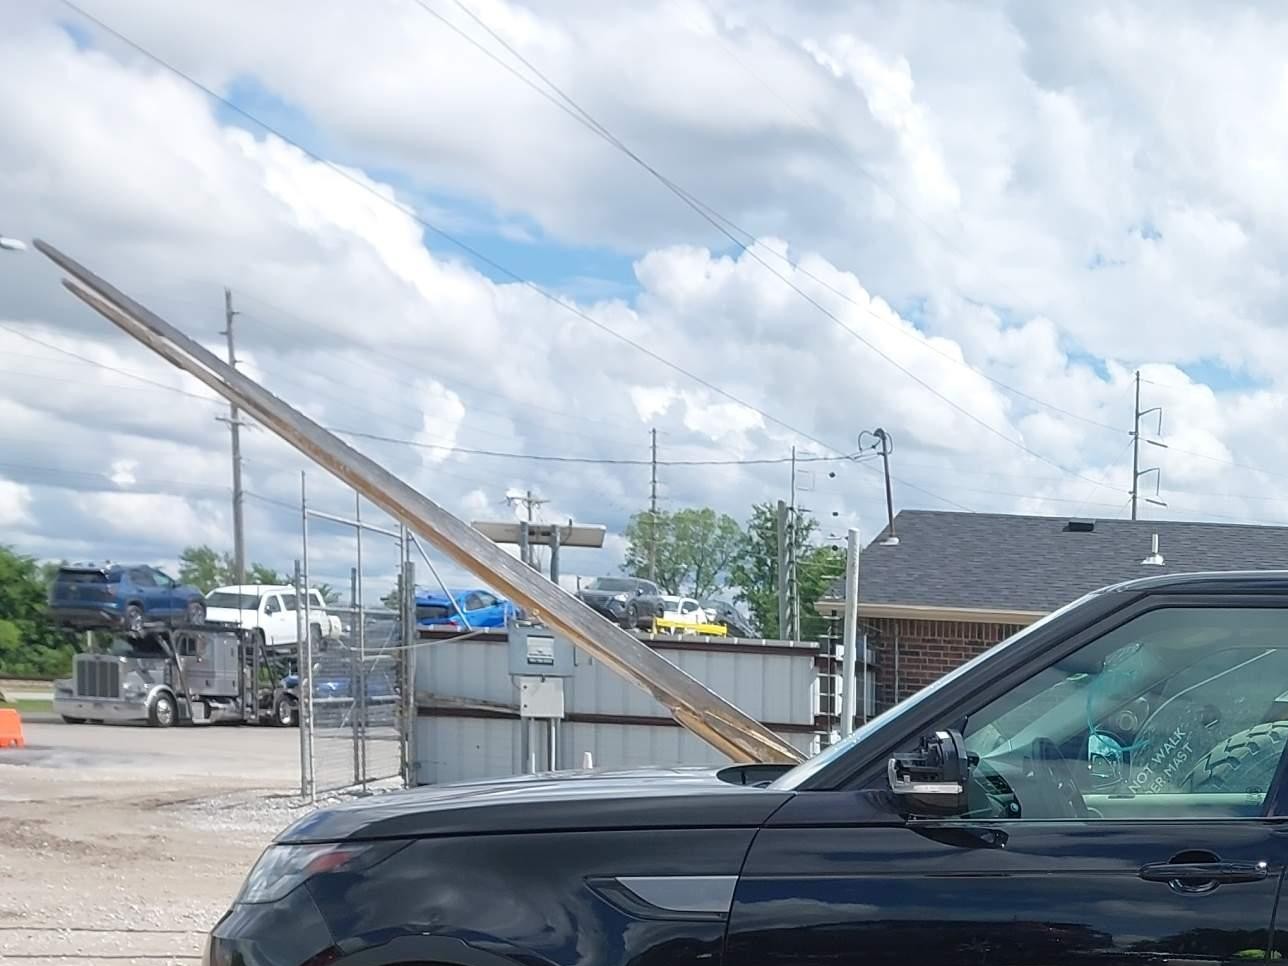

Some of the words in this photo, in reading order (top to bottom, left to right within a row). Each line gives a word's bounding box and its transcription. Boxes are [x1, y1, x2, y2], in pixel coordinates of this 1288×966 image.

[1128, 763, 1154, 794] NOT
[1152, 727, 1186, 764] WALK
[1163, 742, 1193, 777] MAST
